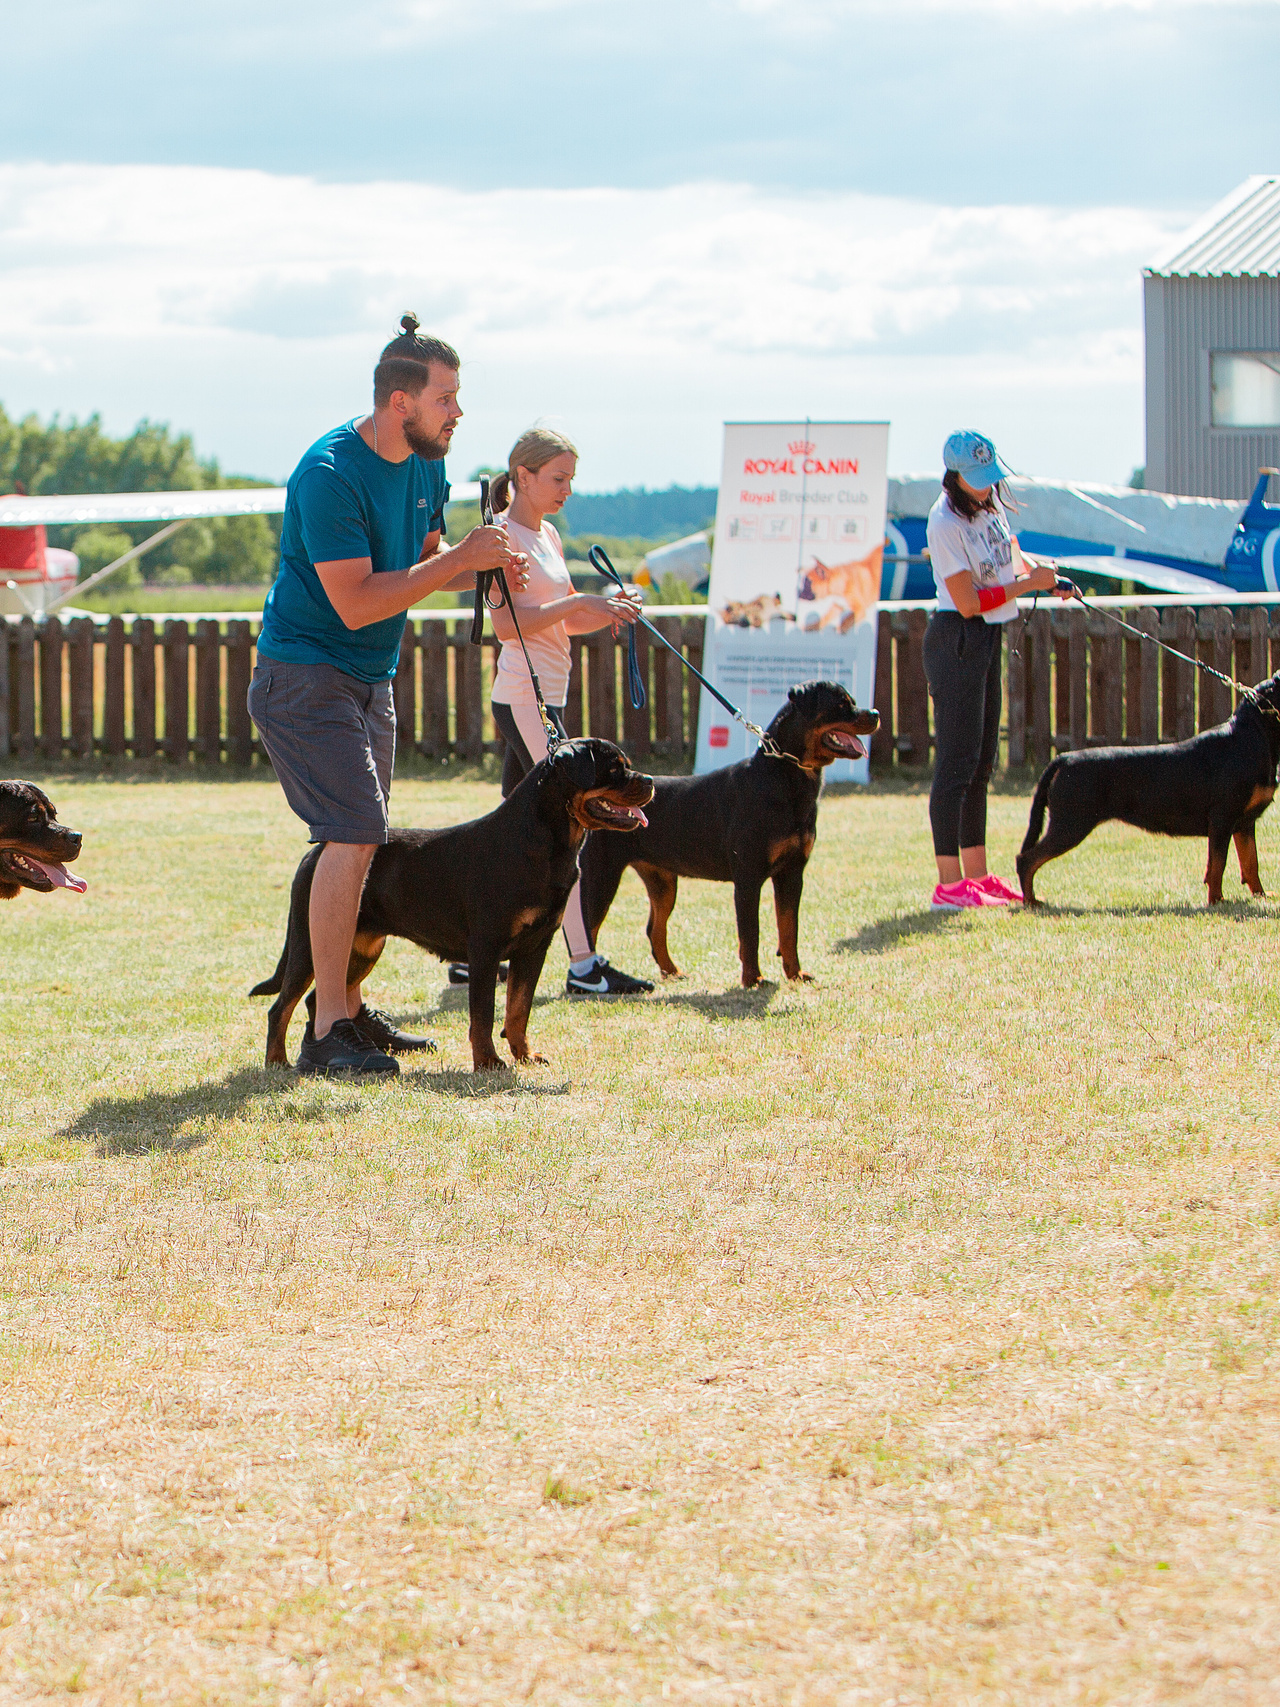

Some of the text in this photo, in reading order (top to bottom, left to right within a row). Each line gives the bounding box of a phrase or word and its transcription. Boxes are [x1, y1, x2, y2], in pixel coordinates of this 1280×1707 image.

[743, 459, 859, 475] ROYAL CANIN
[740, 490, 775, 507] Royal
[838, 490, 868, 504] Club
